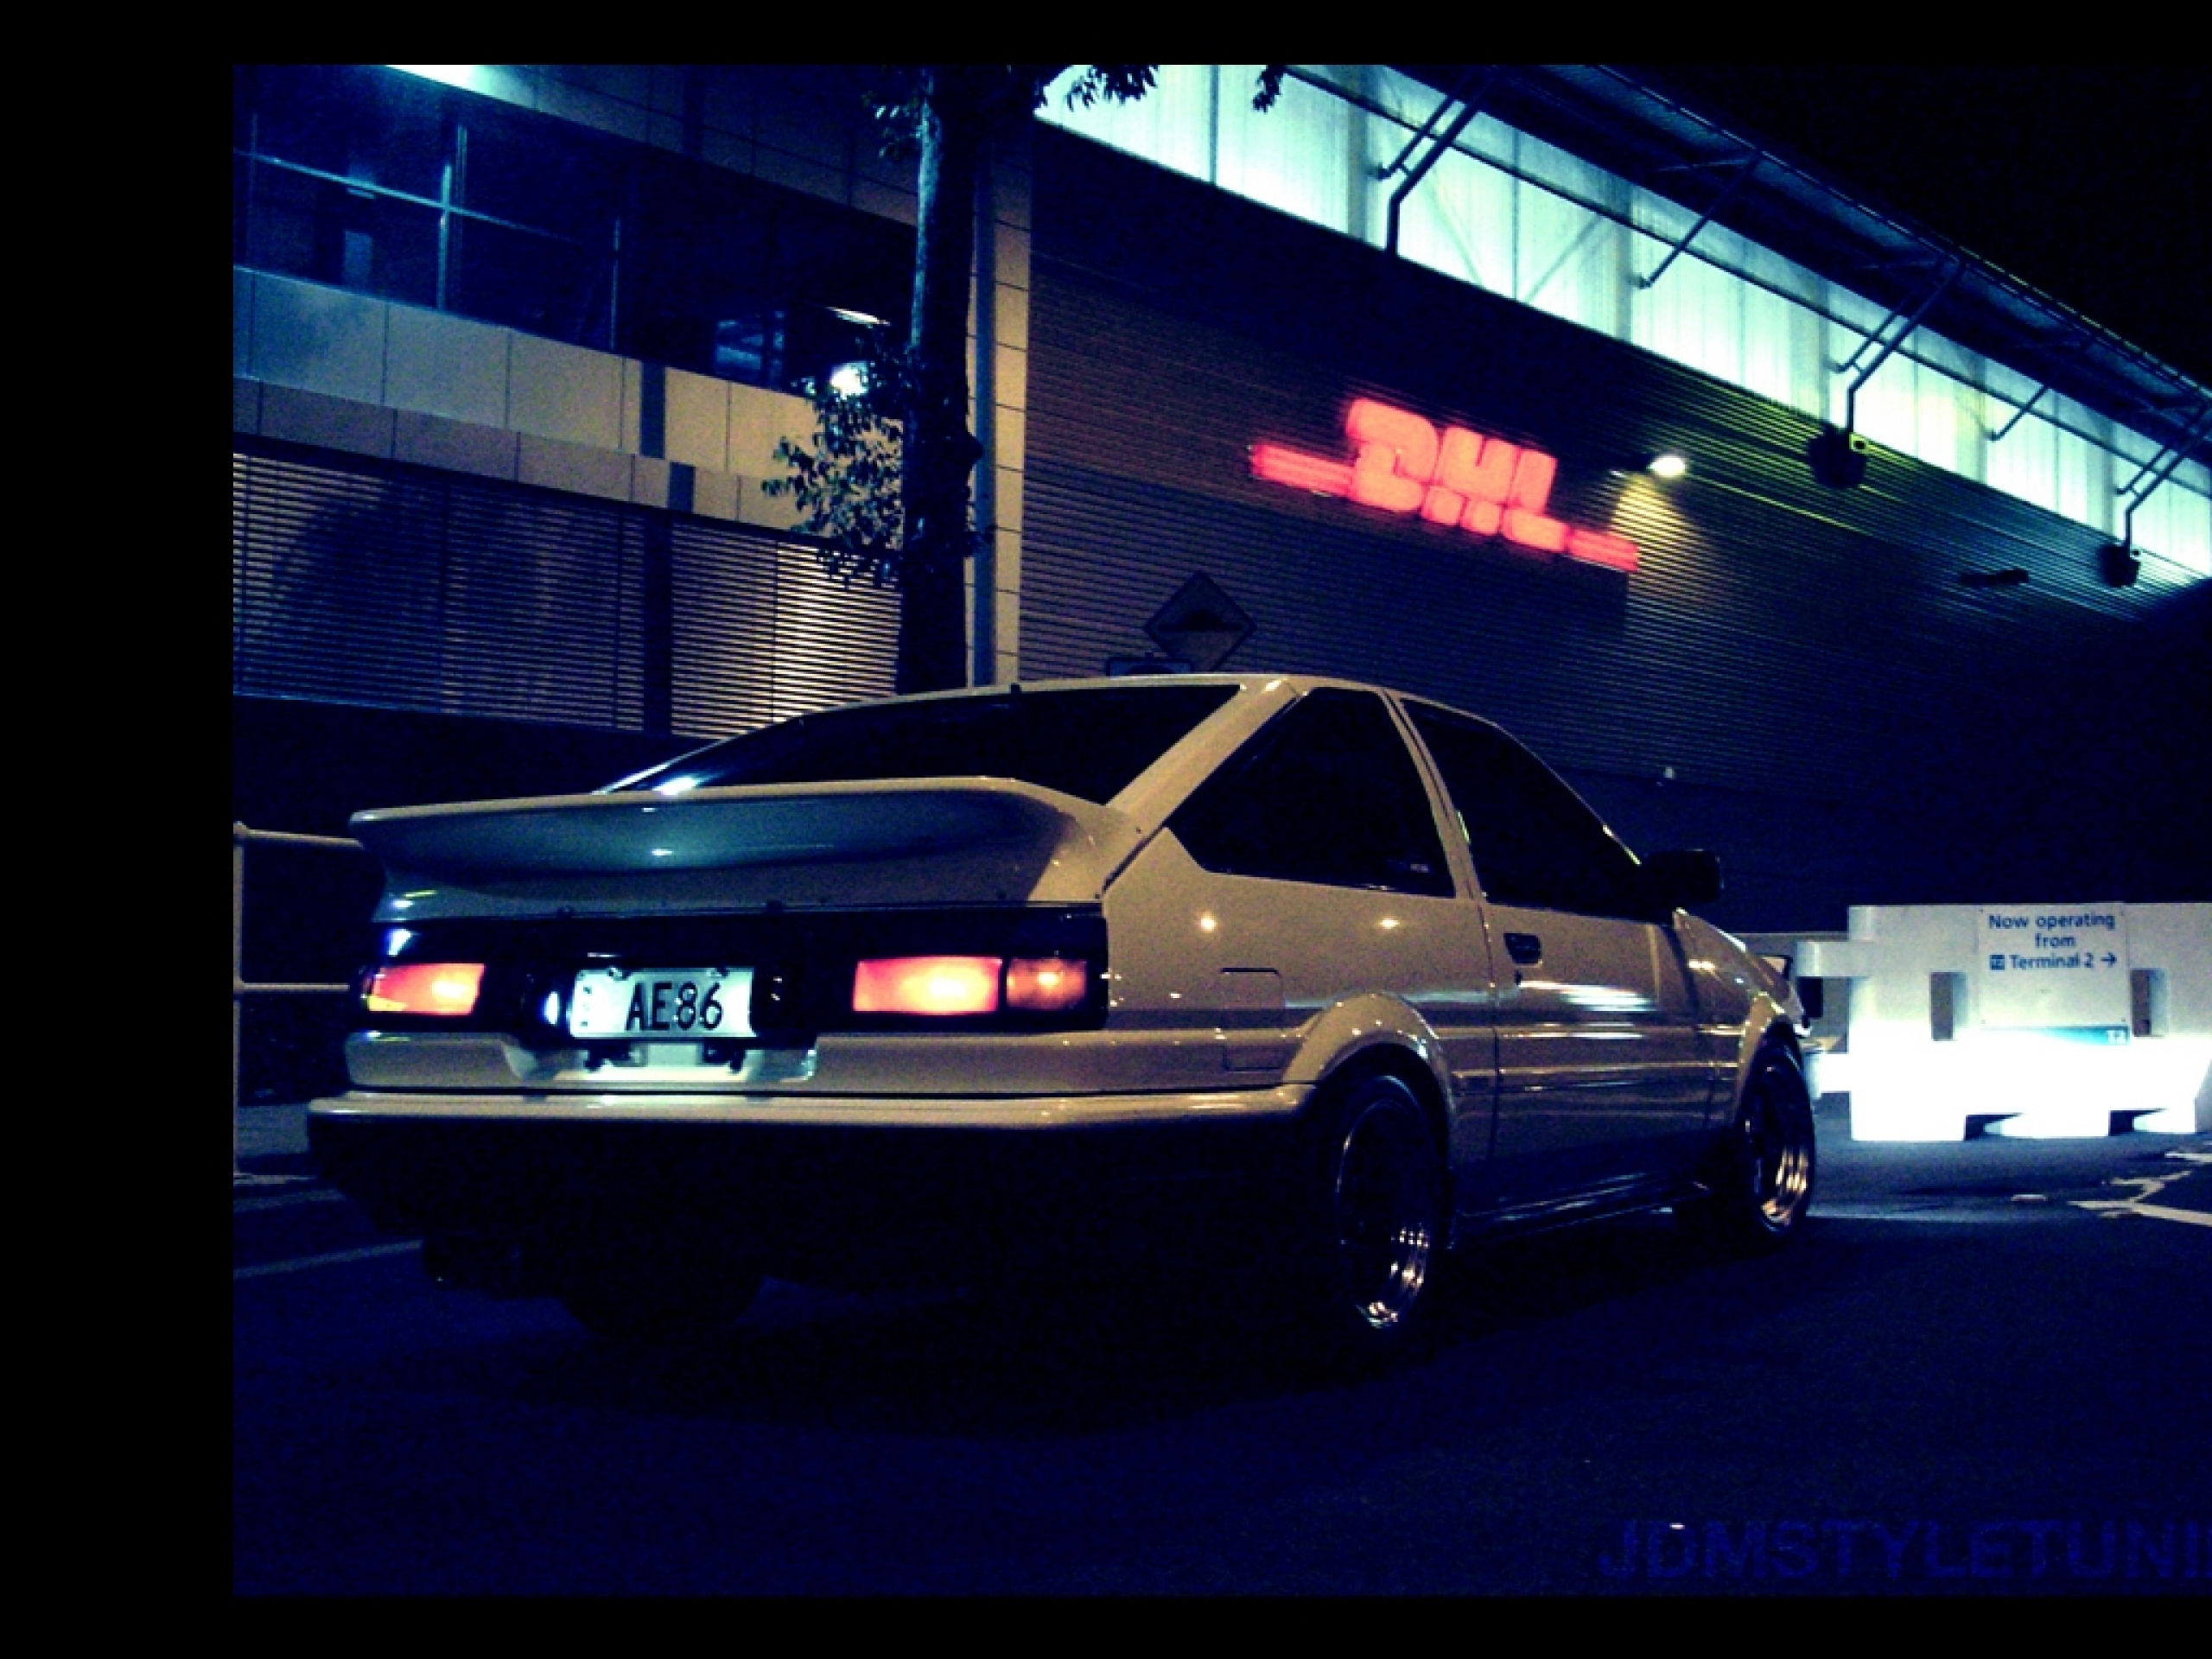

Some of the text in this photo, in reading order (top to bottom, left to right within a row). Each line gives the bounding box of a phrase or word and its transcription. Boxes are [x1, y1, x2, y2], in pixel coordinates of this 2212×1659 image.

[1345, 397, 1567, 551] DHL
[1989, 913, 2115, 931] Now operating
[2035, 933, 2075, 947] from
[2010, 954, 2081, 969] Terminal
[2084, 953, 2094, 968] 2
[625, 981, 724, 1031] AE86
